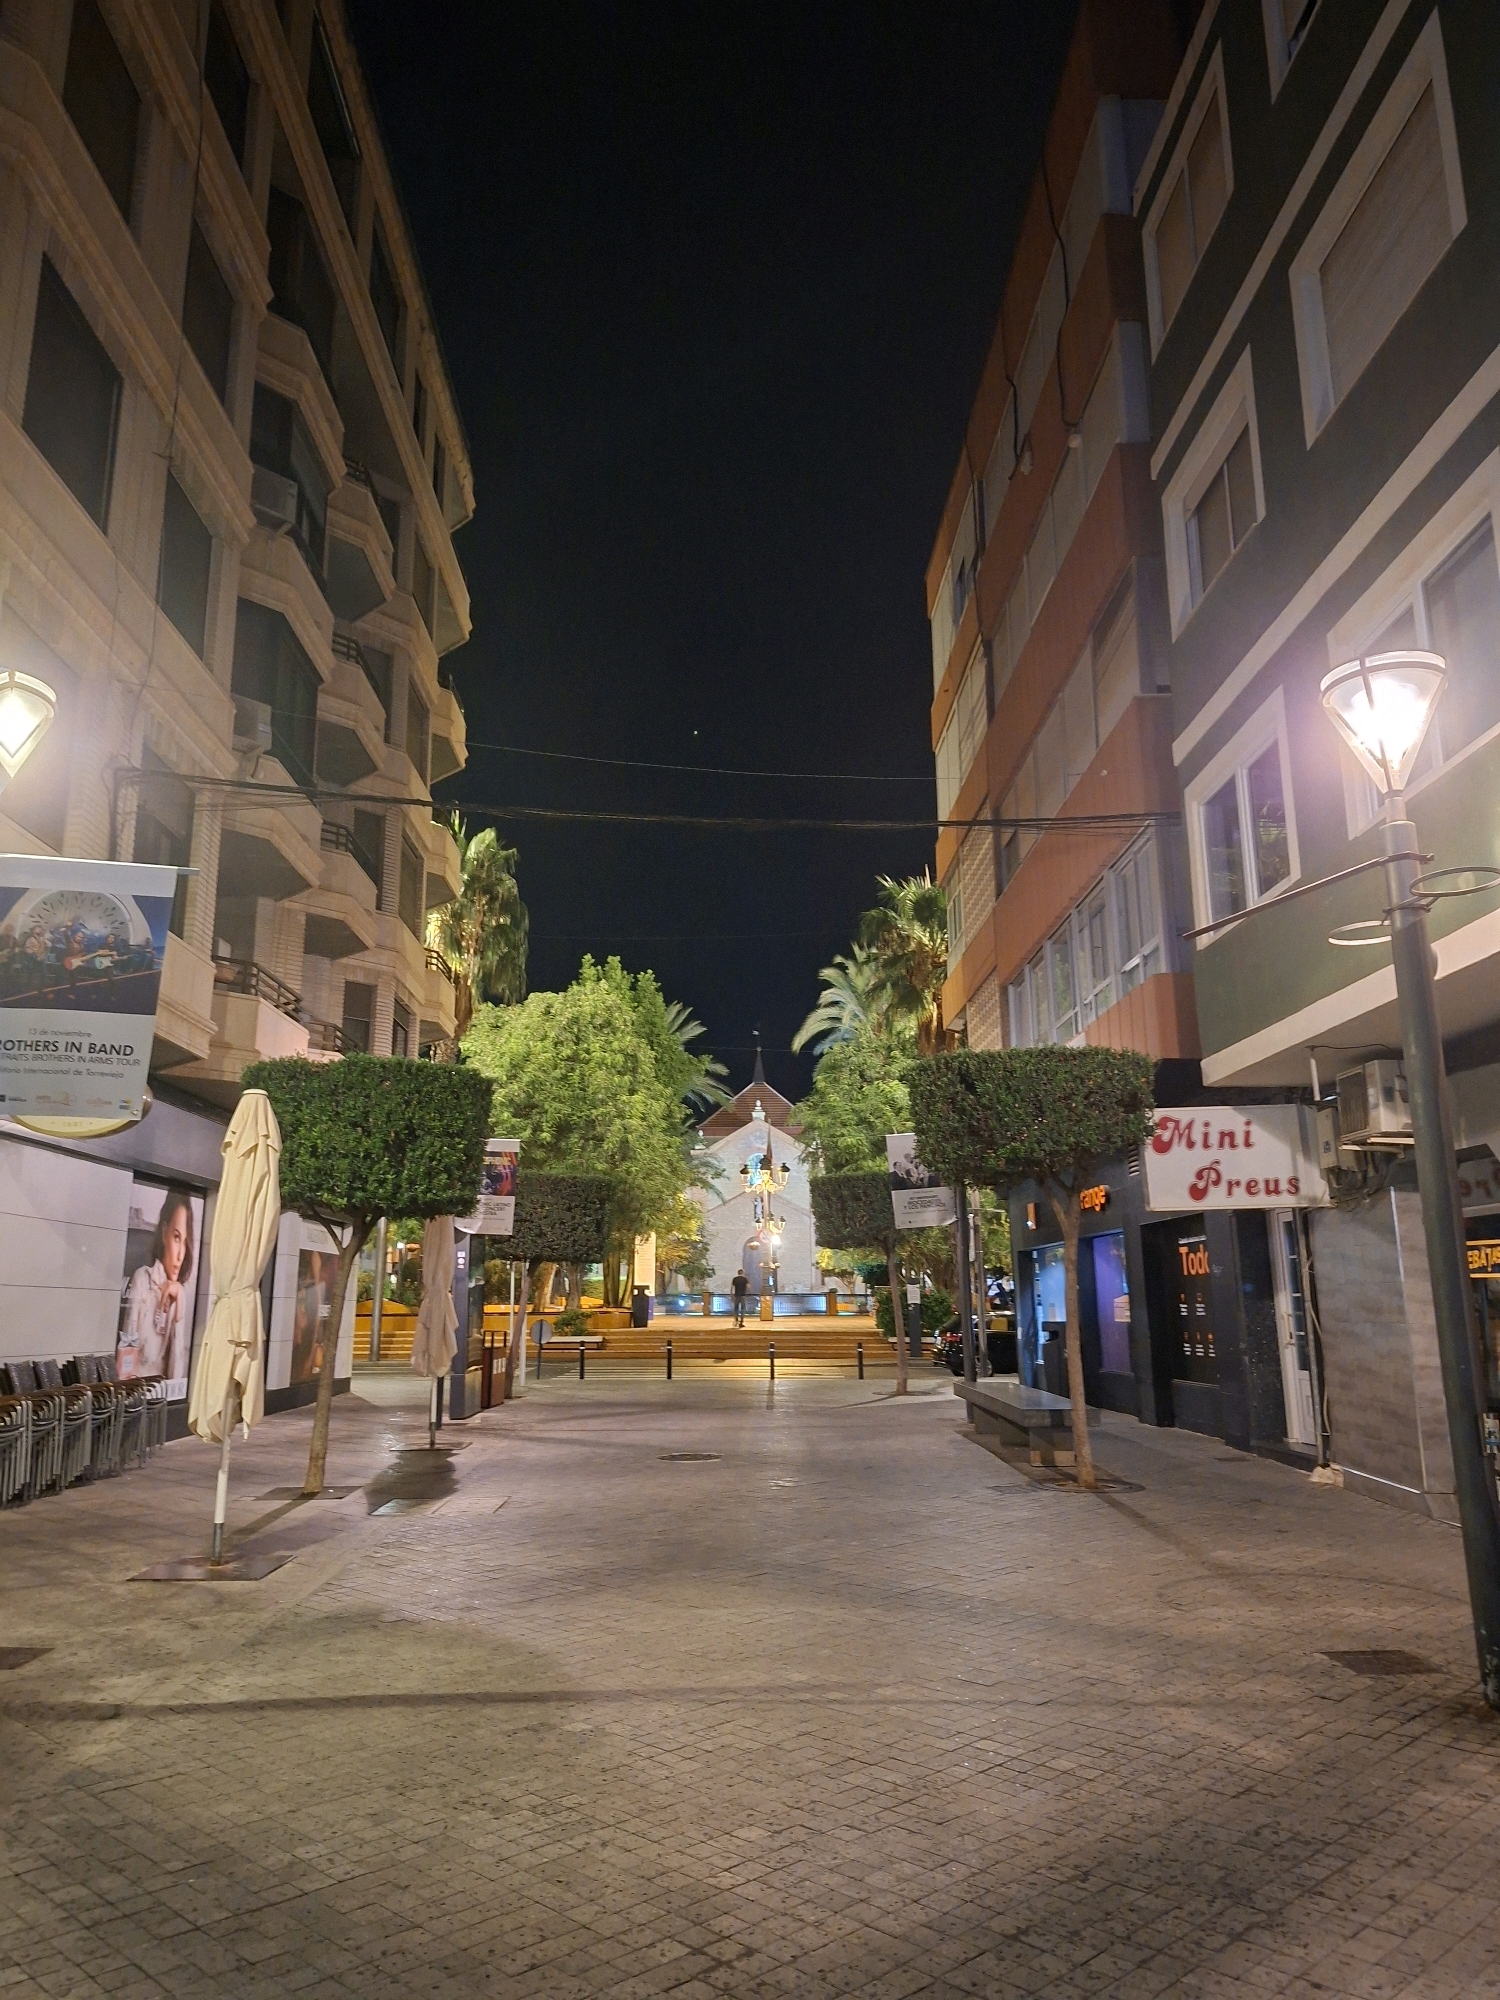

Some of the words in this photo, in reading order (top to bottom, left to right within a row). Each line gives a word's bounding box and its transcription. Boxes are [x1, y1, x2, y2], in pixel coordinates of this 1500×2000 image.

[39, 1028, 49, 1036] de
[51, 1030, 92, 1038] noviembre
[0, 1040, 59, 1052] OTHERS
[64, 1041, 82, 1054] IN
[88, 1043, 134, 1056] BAND
[32, 1054, 76, 1064] BROTHERS
[77, 1055, 87, 1064] IN
[88, 1056, 114, 1066] ARMS
[116, 1058, 141, 1067] TOUR
[73, 1067, 83, 1076] de
[86, 1068, 124, 1079] Torrevieja
[1151, 1114, 1254, 1155] Mini
[1188, 1159, 1300, 1203] Preus
[1080, 1185, 1107, 1212] range
